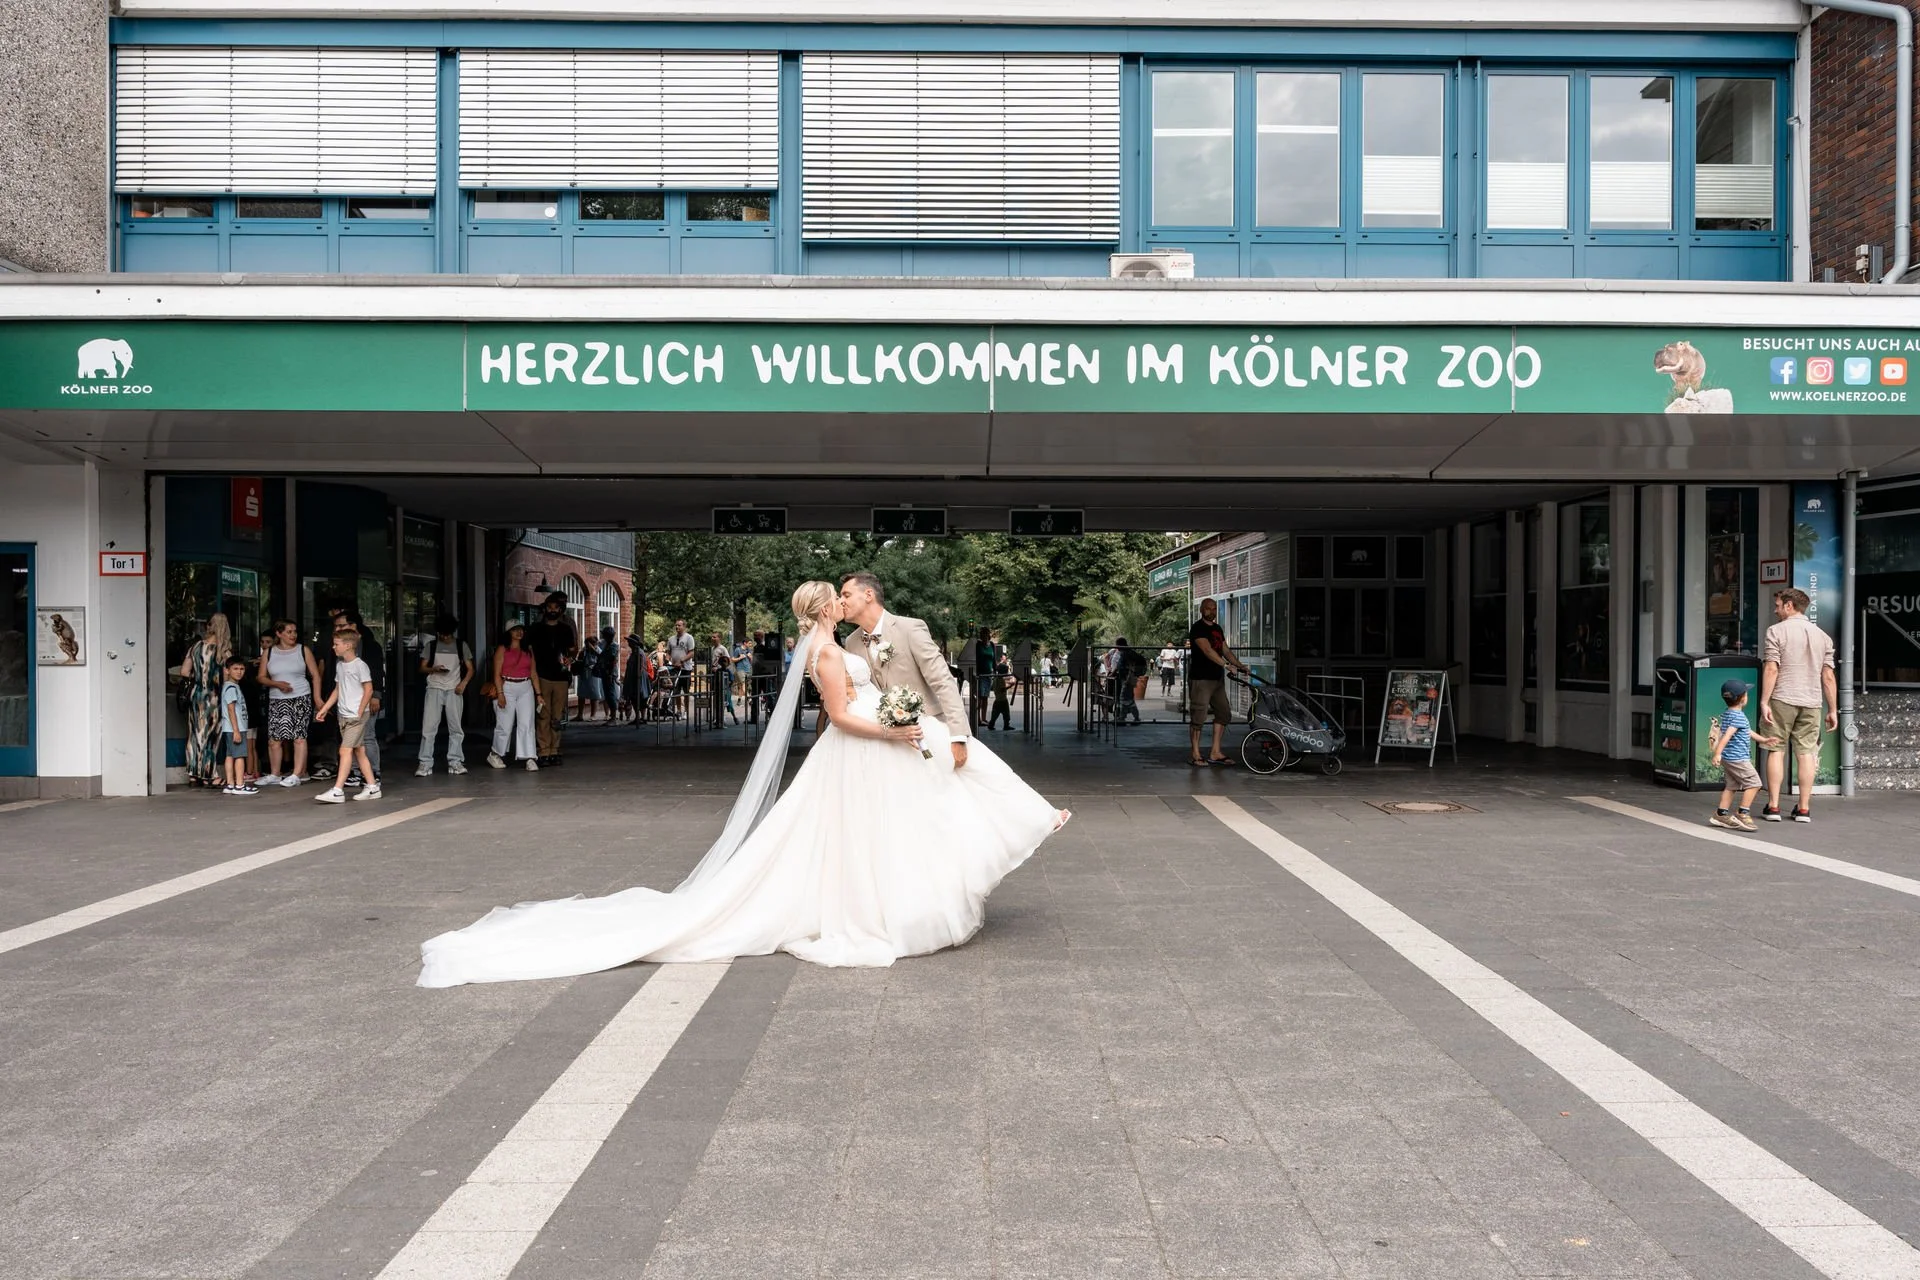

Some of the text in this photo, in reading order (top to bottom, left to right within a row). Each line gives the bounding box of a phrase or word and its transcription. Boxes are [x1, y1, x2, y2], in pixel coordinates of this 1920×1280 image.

[1742, 337, 1815, 351] BESUCHT
[1819, 338, 1852, 351] UNS
[1855, 338, 1900, 351] AUCH
[481, 334, 1542, 388] HERZLICH WILLKOMMEN IM KÖLNER ZOO
[61, 383, 153, 395] KÖLNER ZOO
[1769, 391, 1907, 402] WWW.KOELNERZOO.DE
[110, 557, 135, 569] Tor 1
[1766, 565, 1781, 577] Tor 1
[1810, 600, 1817, 612] DA
